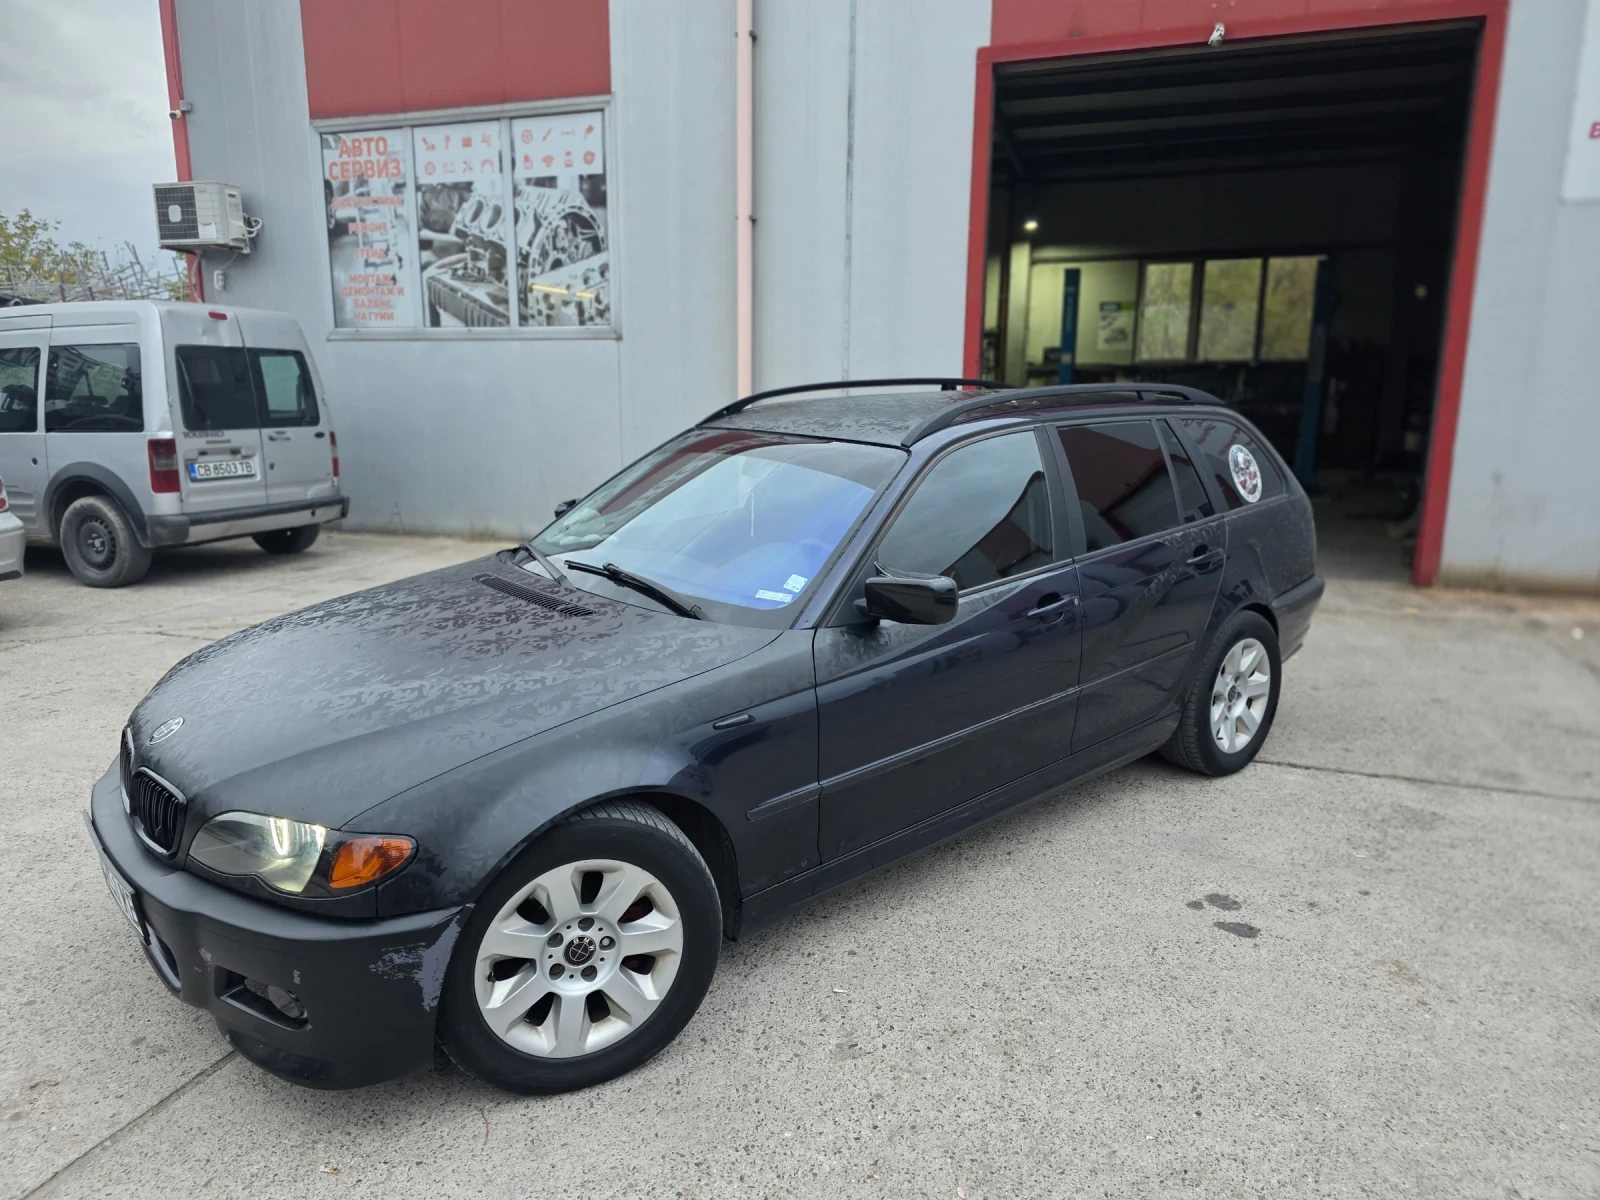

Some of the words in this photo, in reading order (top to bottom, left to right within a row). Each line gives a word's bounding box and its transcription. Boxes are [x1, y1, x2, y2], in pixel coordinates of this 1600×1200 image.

[338, 136, 388, 158] АВТО
[328, 158, 401, 180] СЕРВИЗ
[341, 286, 395, 298] ДЕМОНТАЖ
[354, 311, 367, 321] НА
[368, 311, 394, 321] ГУМИ
[213, 462, 238, 476] 8503
